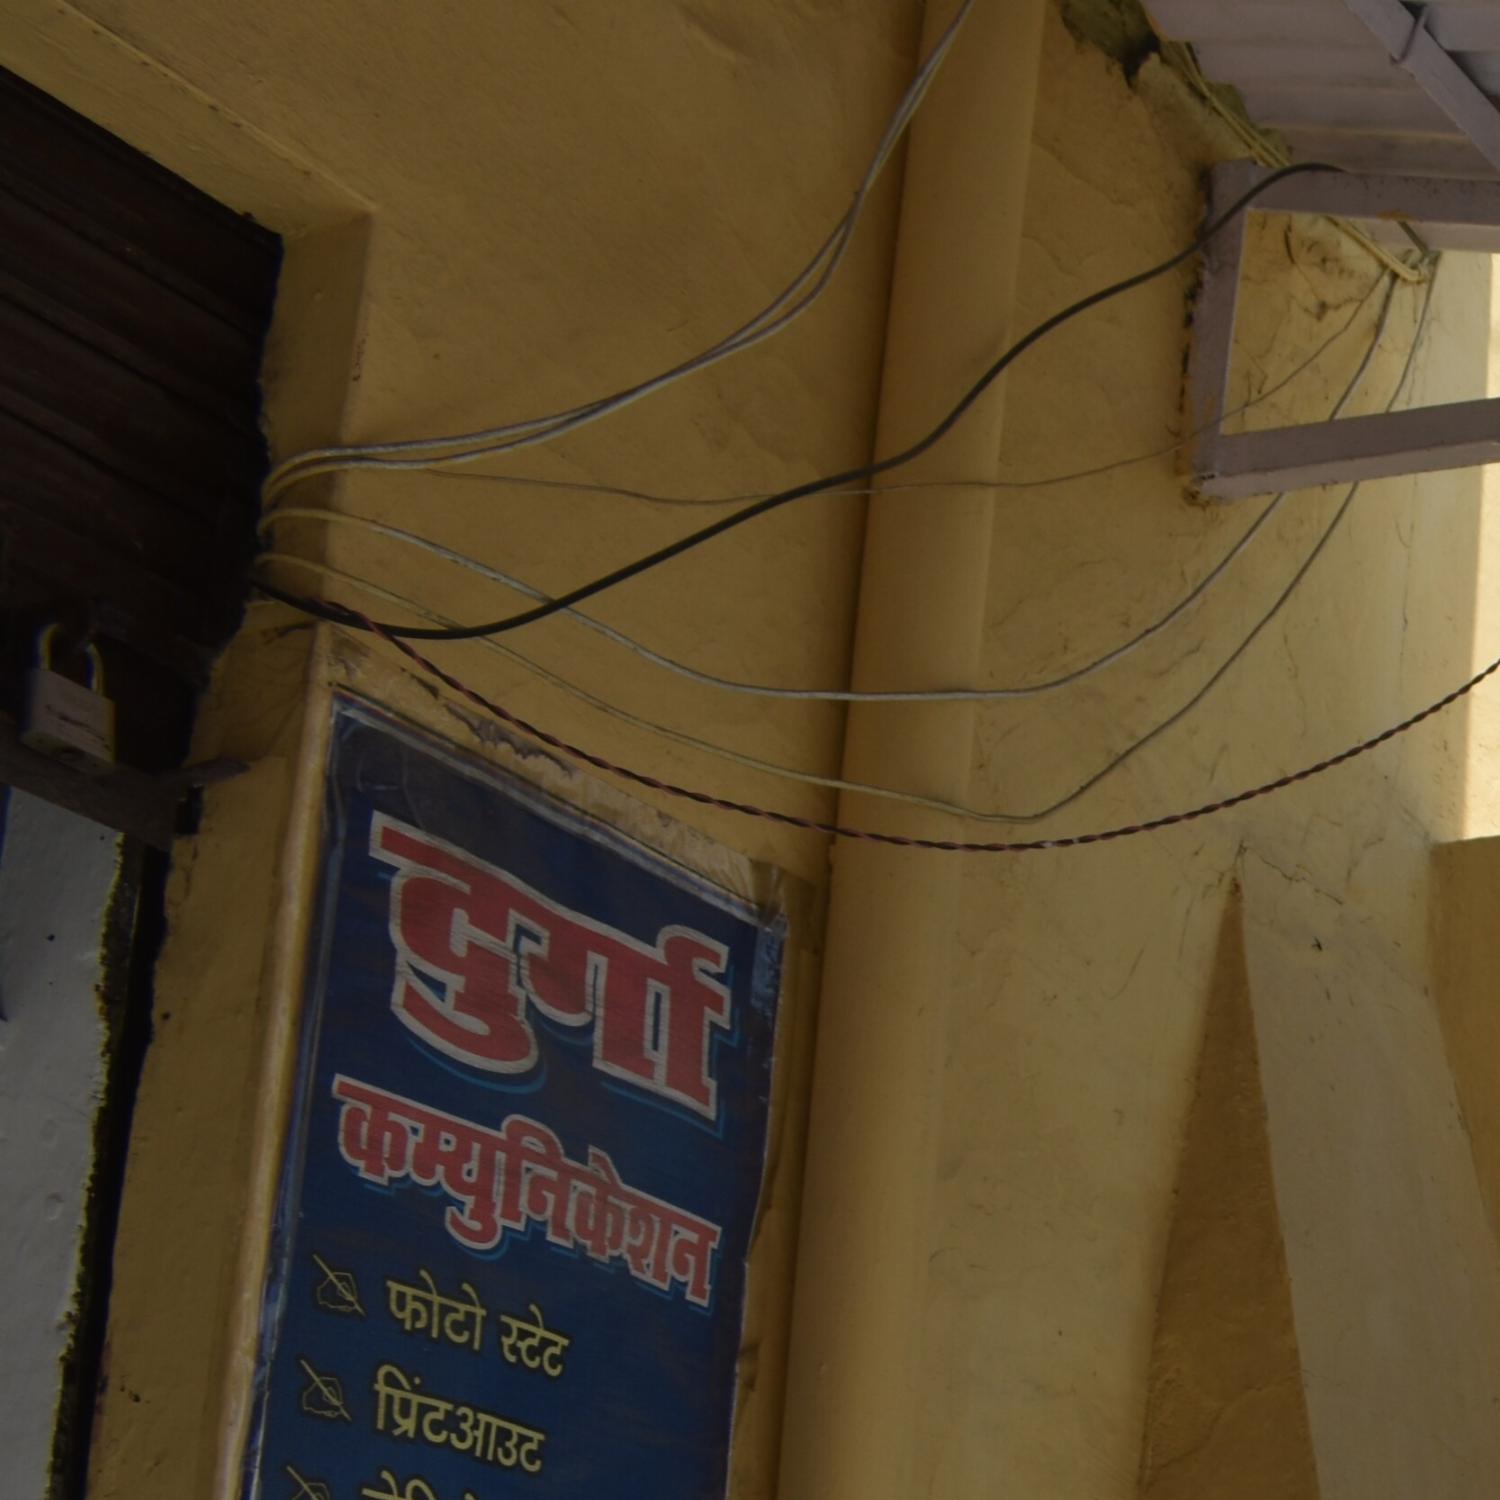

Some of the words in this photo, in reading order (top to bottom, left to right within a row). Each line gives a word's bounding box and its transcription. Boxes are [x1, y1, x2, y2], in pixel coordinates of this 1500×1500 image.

[369, 811, 731, 1119] दुर्गा
[332, 1074, 722, 1307] कम्युनिकेशन
[387, 1272, 486, 1350] फोटो
[499, 1306, 570, 1378] स्टेट
[374, 1364, 545, 1473] प्रिंटआउट
